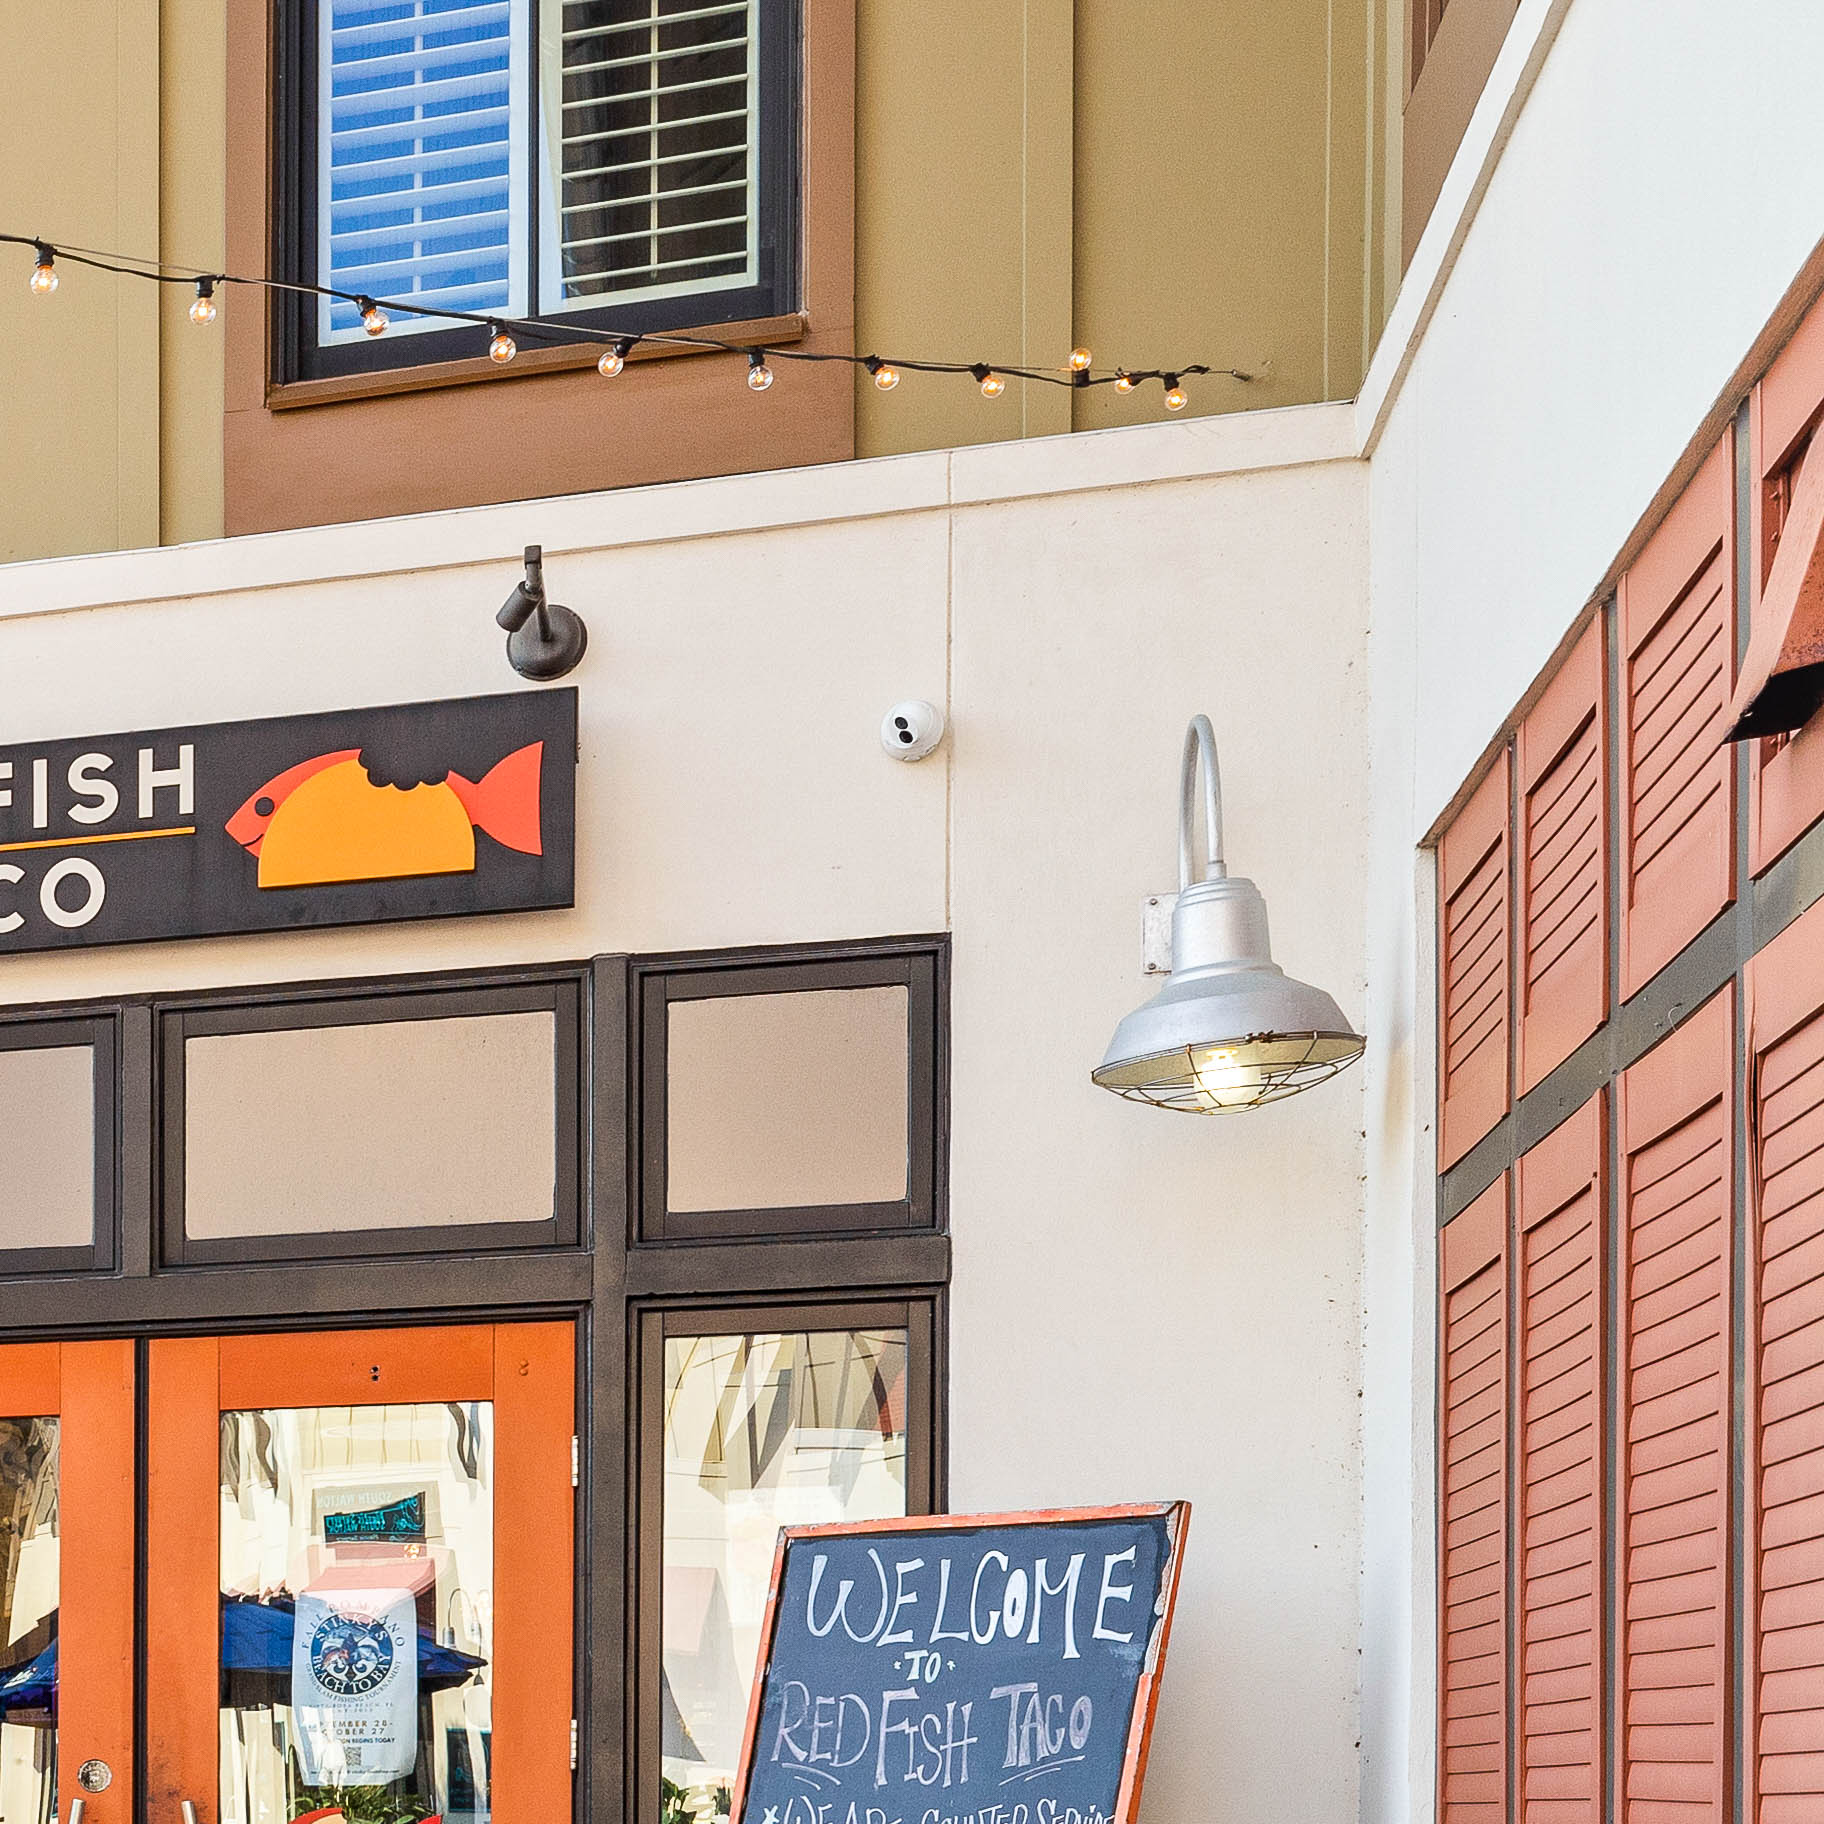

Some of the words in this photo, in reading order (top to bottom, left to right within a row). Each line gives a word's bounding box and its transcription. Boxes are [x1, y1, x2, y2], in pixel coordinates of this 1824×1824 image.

[806, 1545, 1136, 1659] WELCOME
[313, 1655, 346, 1693] BEACH
[350, 1680, 372, 1694] TO
[371, 1655, 391, 1682] BAY
[904, 1649, 942, 1683] TO
[770, 1681, 871, 1766] RED
[875, 1688, 979, 1789] FISH
[991, 1682, 1093, 1768] TACO
